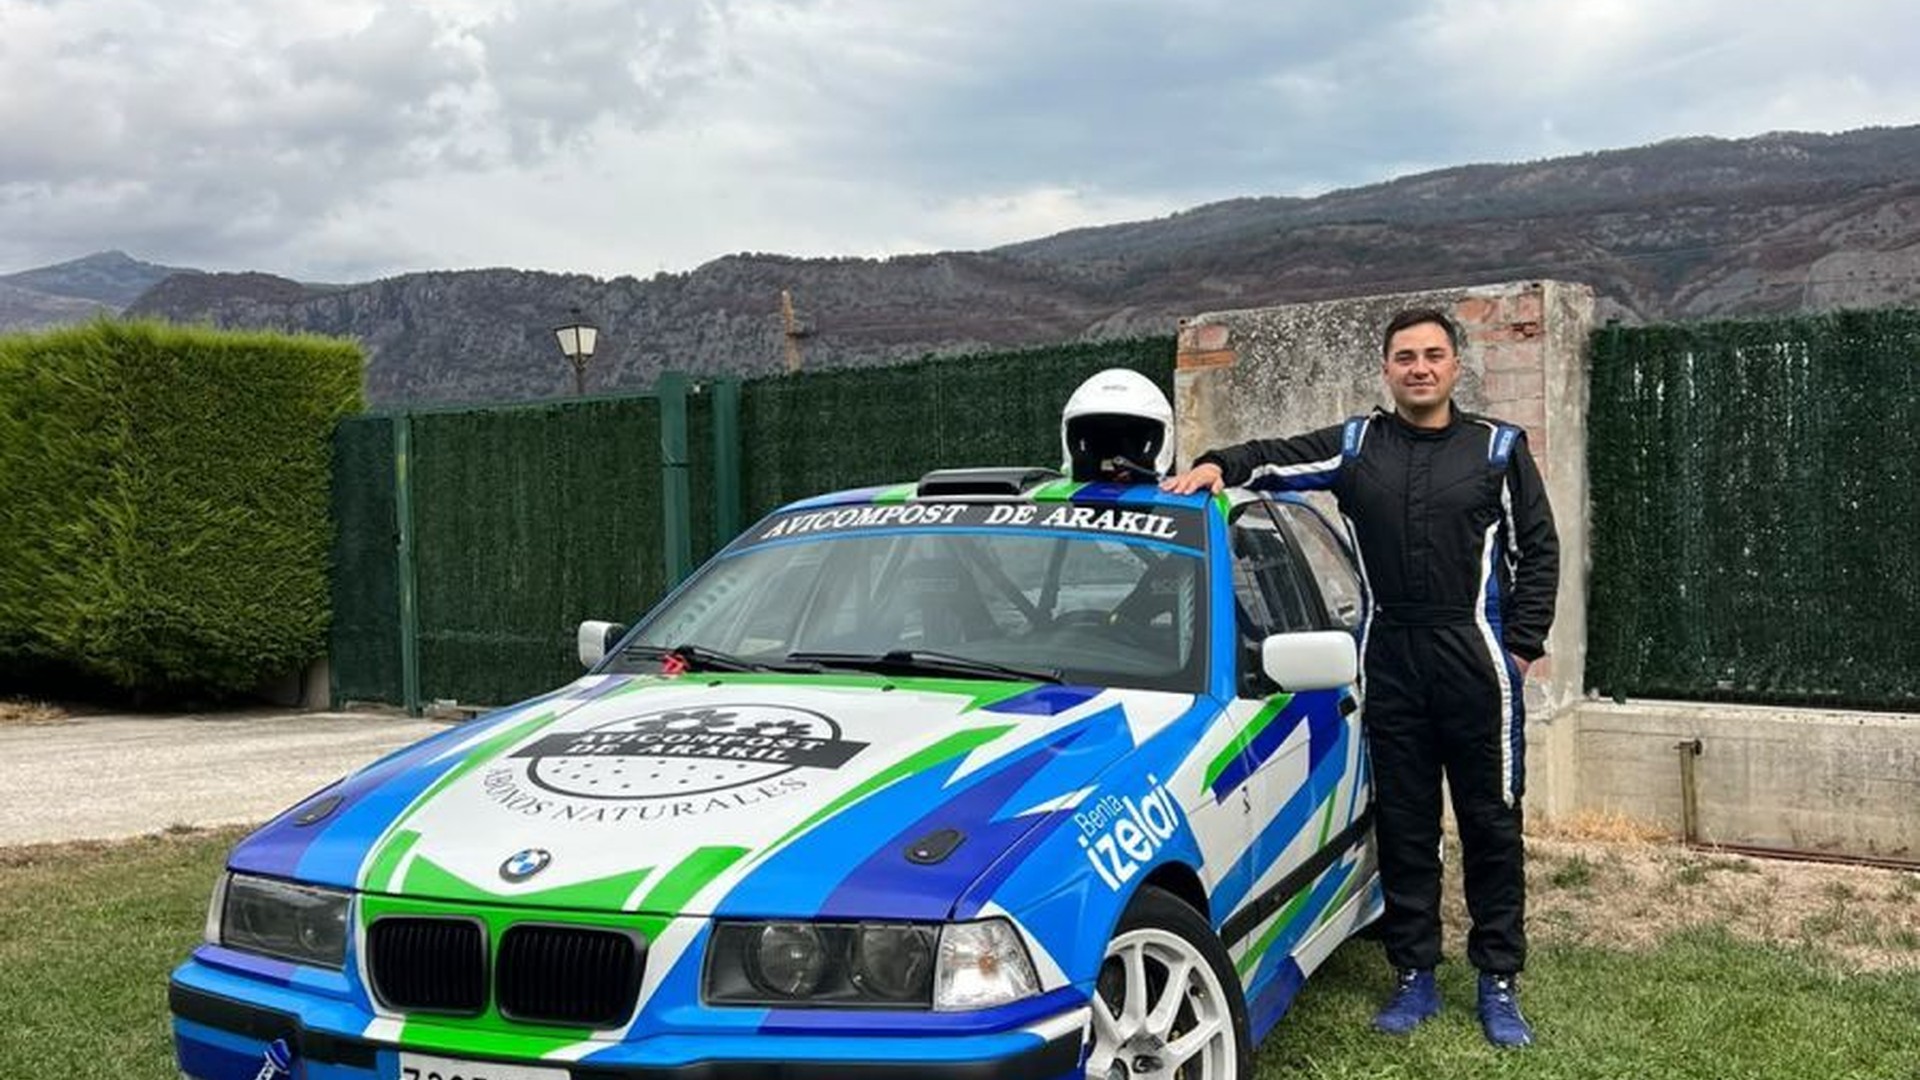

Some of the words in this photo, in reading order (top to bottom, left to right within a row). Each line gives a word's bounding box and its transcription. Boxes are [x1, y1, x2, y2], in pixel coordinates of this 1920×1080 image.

[760, 504, 969, 540] AVICOMPOST
[984, 504, 1038, 526] DE
[1040, 506, 1179, 540] ARAKIL
[564, 743, 622, 754] DE
[637, 744, 790, 761] ARAKIL
[569, 732, 825, 751] AVICOMPOST
[483, 768, 555, 816] ABONOS
[551, 777, 808, 822] NATURALES
[1073, 794, 1125, 838] Benta
[1077, 772, 1180, 893] izelai
